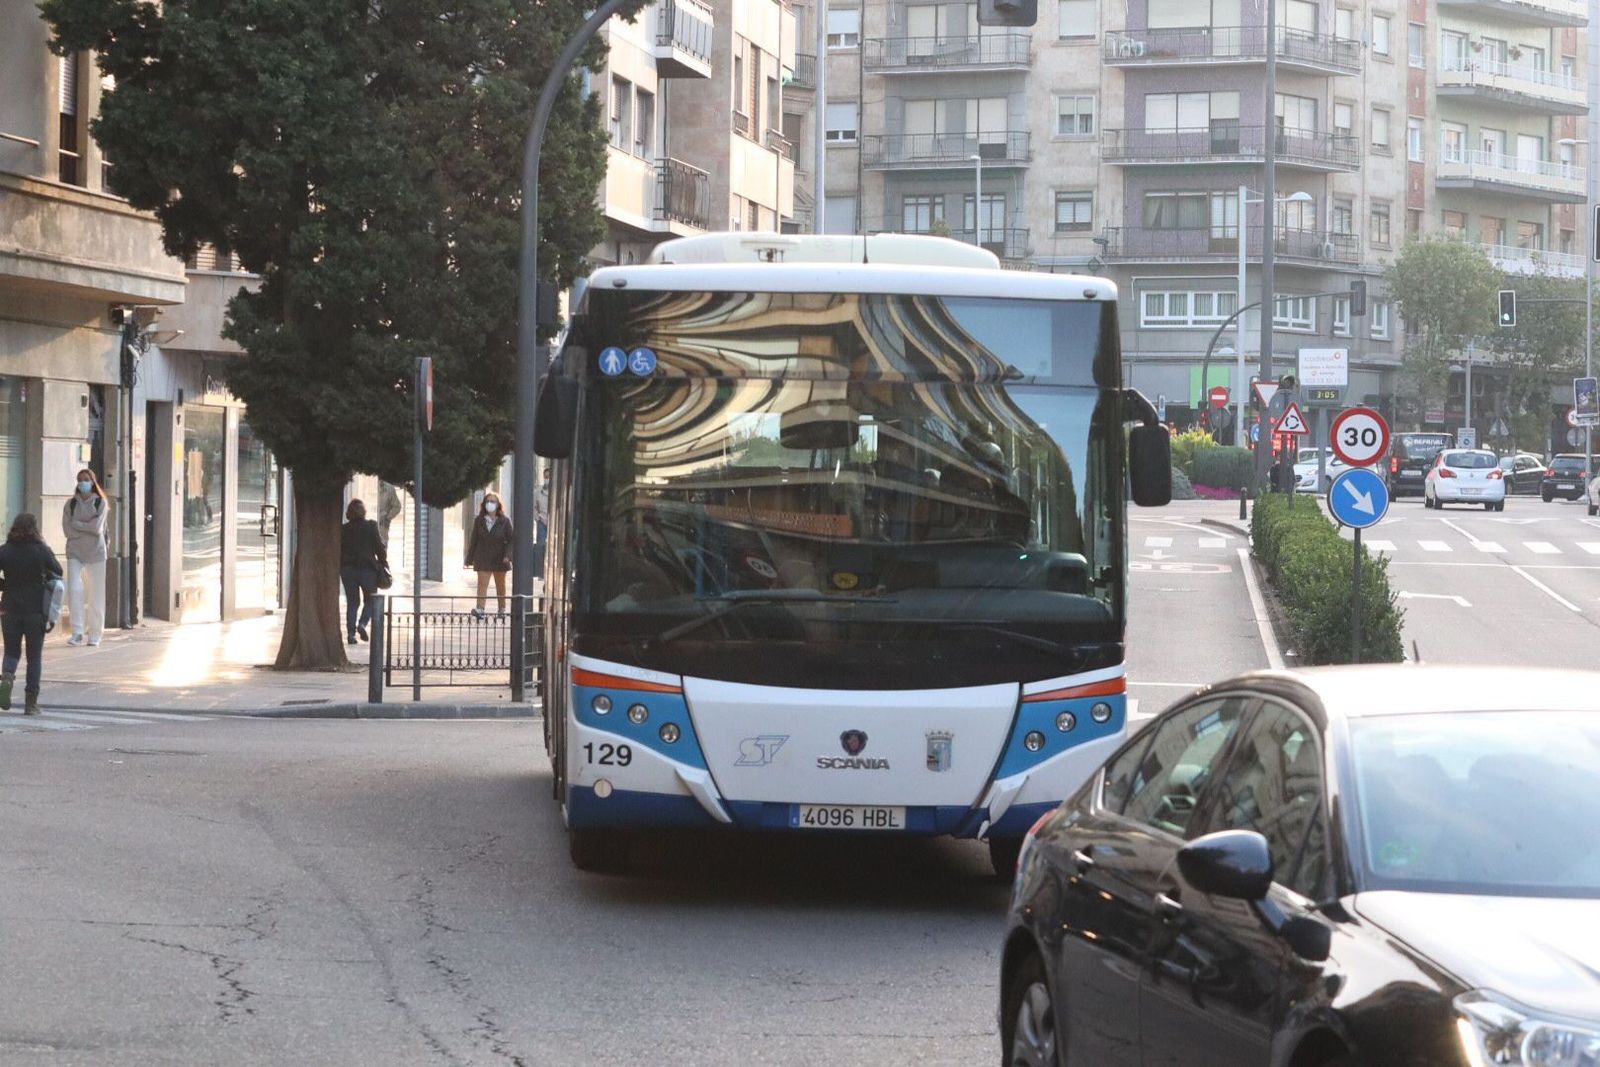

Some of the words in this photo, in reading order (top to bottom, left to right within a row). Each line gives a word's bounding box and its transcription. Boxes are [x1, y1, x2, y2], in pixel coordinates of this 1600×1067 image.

[1344, 427, 1377, 447] 30
[583, 742, 632, 767] 129
[817, 757, 890, 770] SCANIA
[804, 807, 854, 826] 4096
[863, 809, 899, 827] HBL
